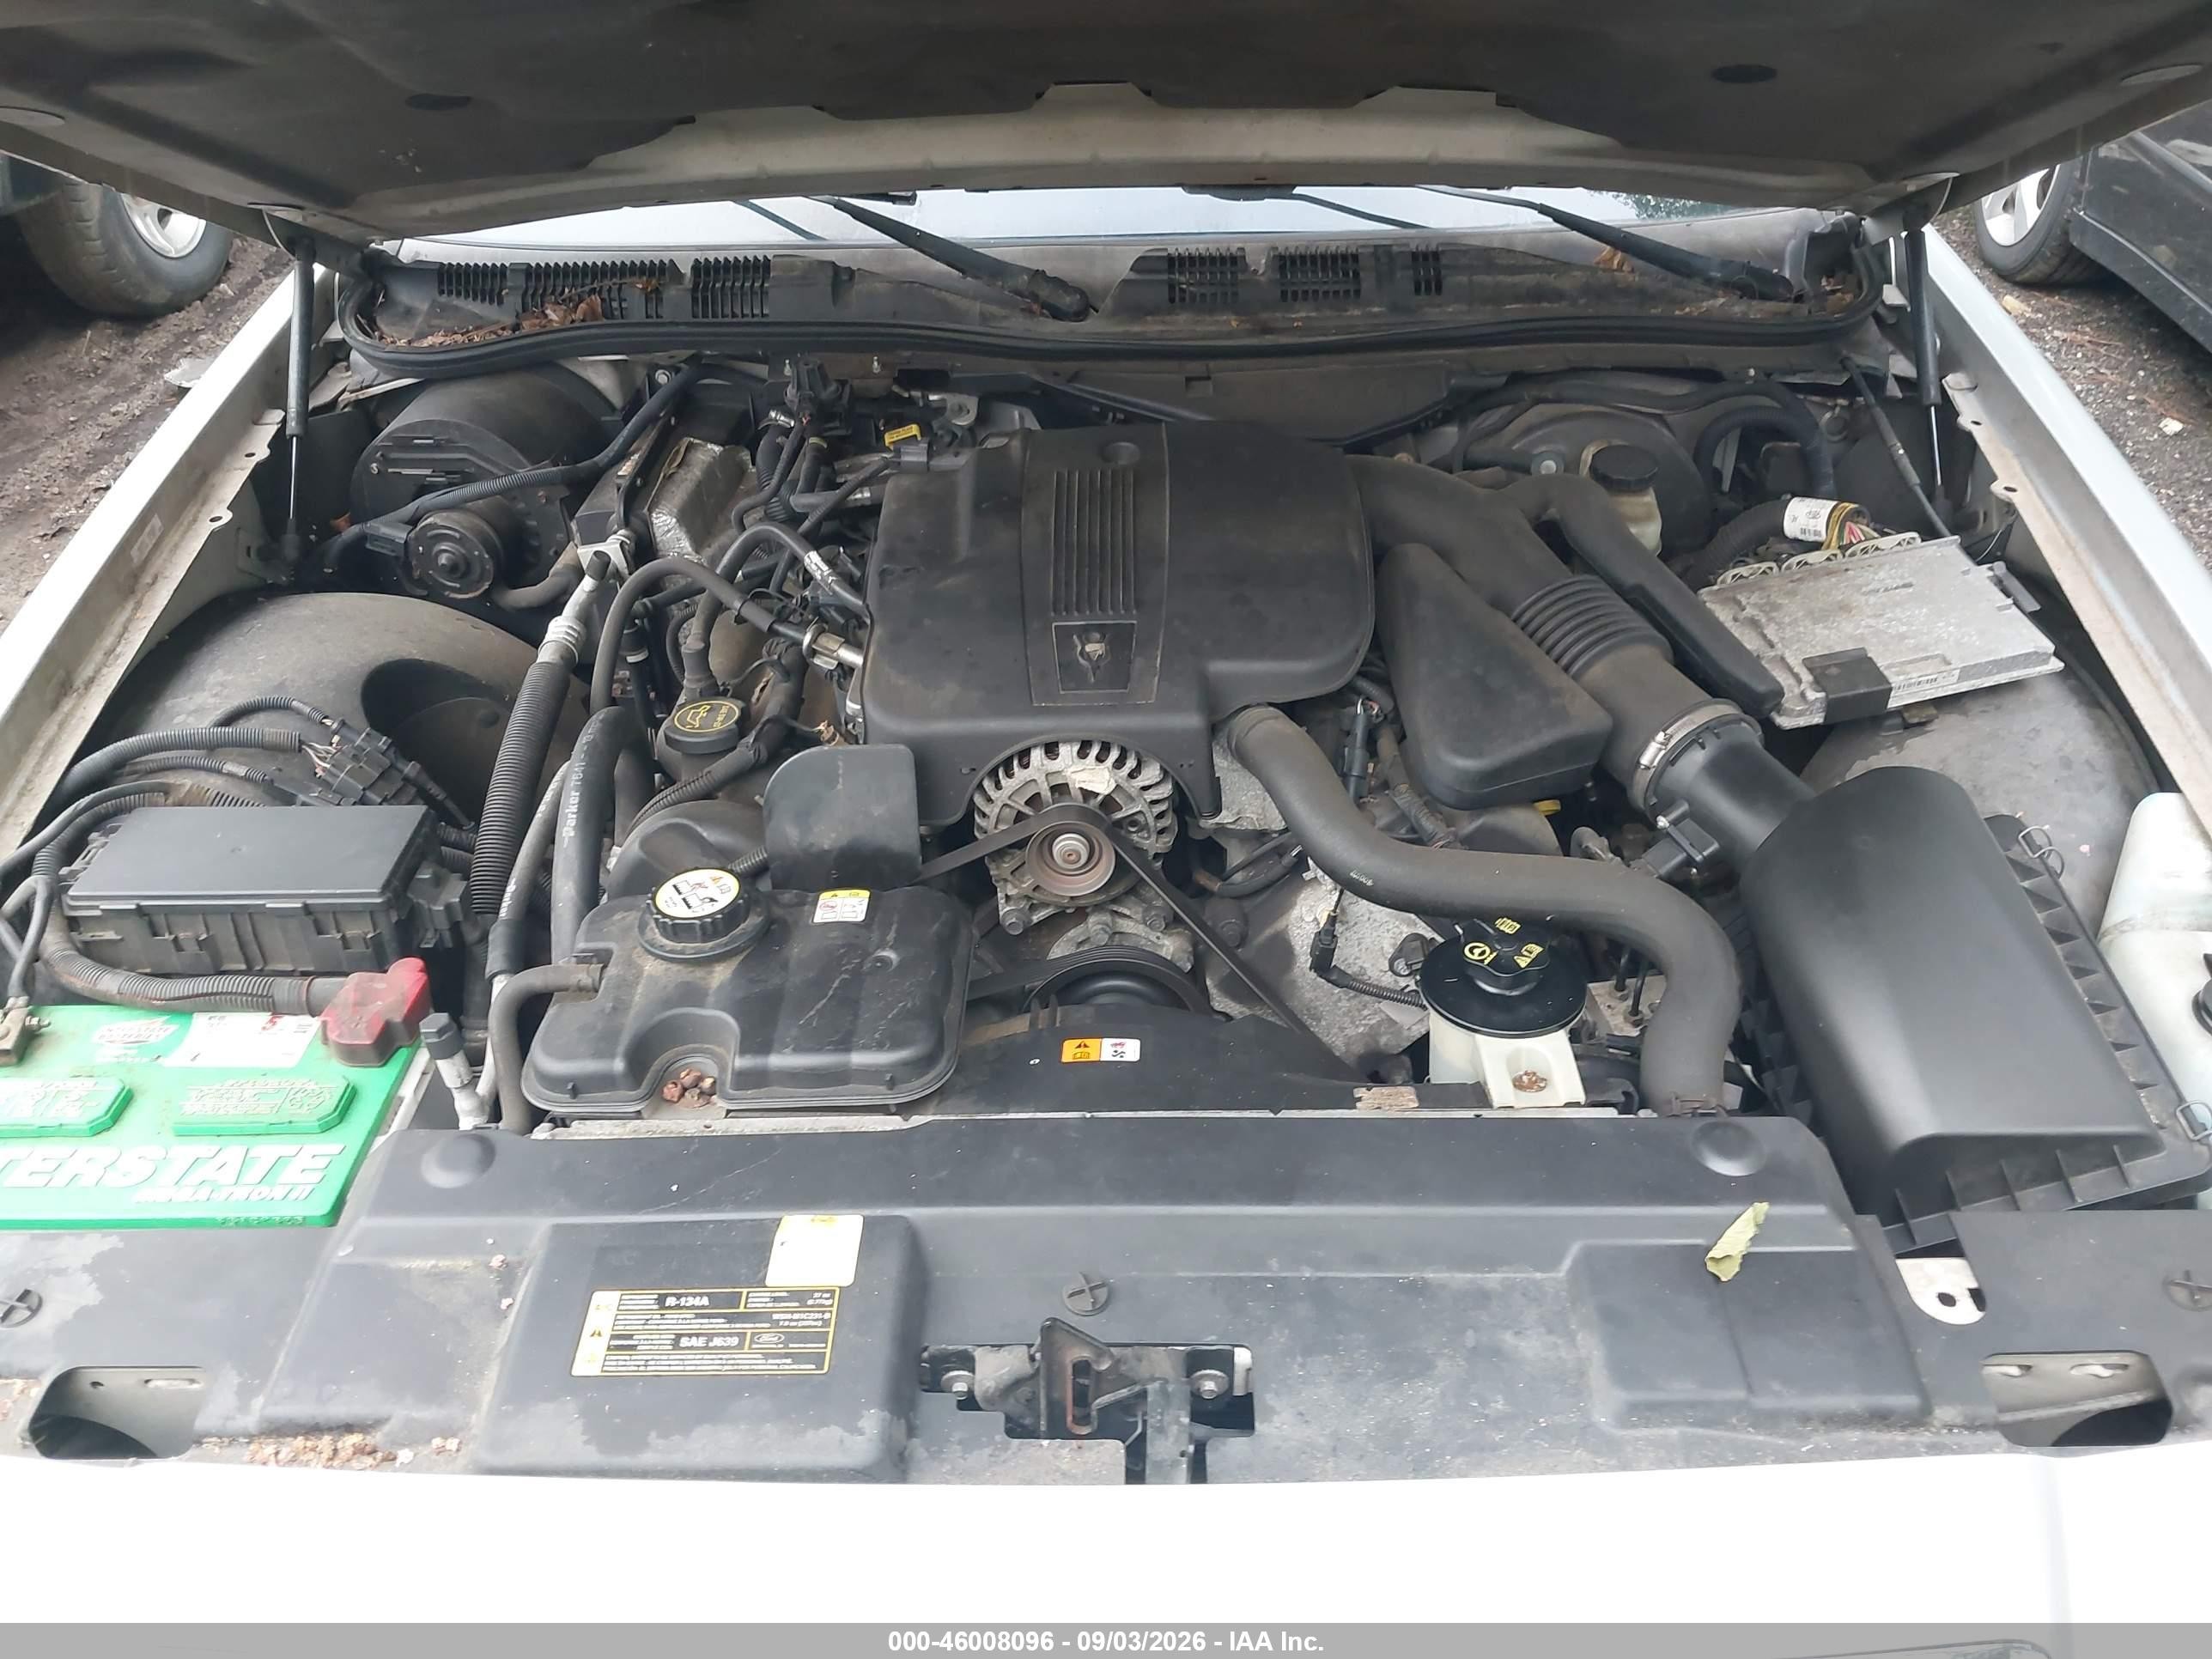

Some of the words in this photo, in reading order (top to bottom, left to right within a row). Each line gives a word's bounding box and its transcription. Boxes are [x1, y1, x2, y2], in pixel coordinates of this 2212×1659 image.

[562, 790, 580, 837] Parker
[665, 1295, 710, 1307] R-134A
[679, 1336, 708, 1348] SAE
[708, 1335, 740, 1347] J639
